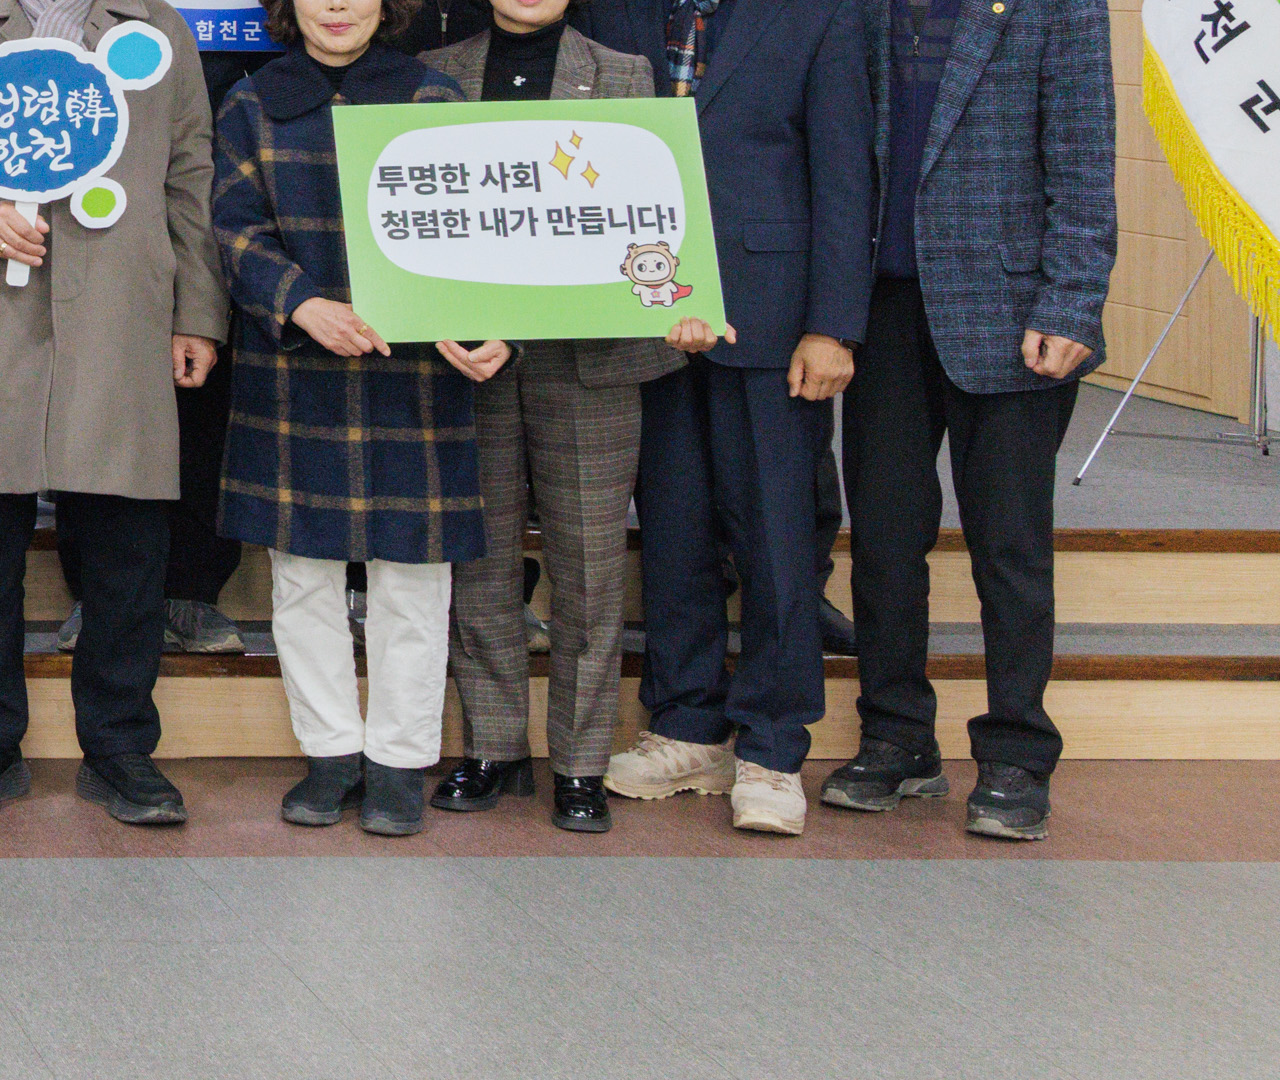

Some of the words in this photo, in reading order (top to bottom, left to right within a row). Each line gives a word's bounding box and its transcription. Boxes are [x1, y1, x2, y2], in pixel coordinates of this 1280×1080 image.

[195, 19, 263, 42] 합천군
[376, 162, 470, 196] 투명한
[479, 161, 542, 194] 사회
[380, 207, 471, 241] 청렴한
[478, 206, 539, 238] 내가
[546, 204, 679, 237] 만듭니다!
